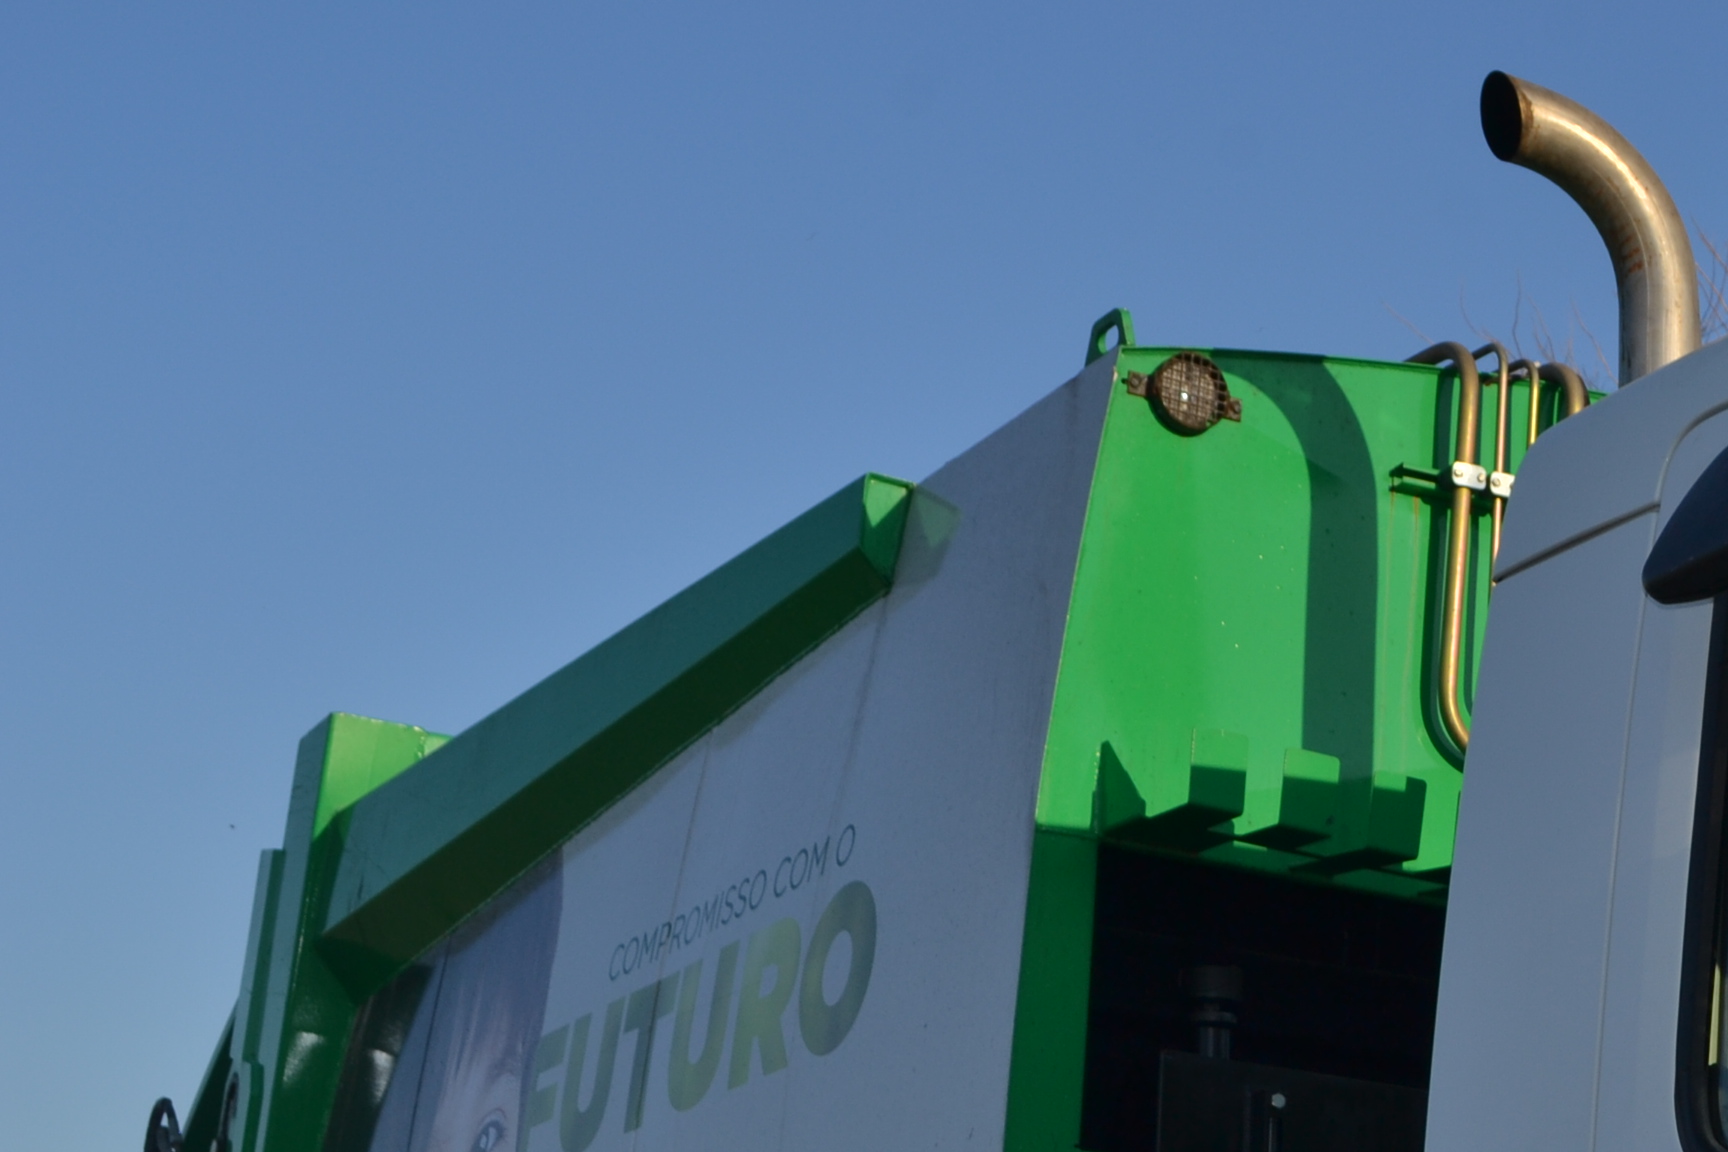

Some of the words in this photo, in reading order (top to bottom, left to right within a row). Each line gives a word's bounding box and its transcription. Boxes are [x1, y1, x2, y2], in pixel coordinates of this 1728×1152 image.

[608, 869, 767, 981] COMPROMISSO
[773, 836, 830, 898] COM
[835, 823, 857, 867] O
